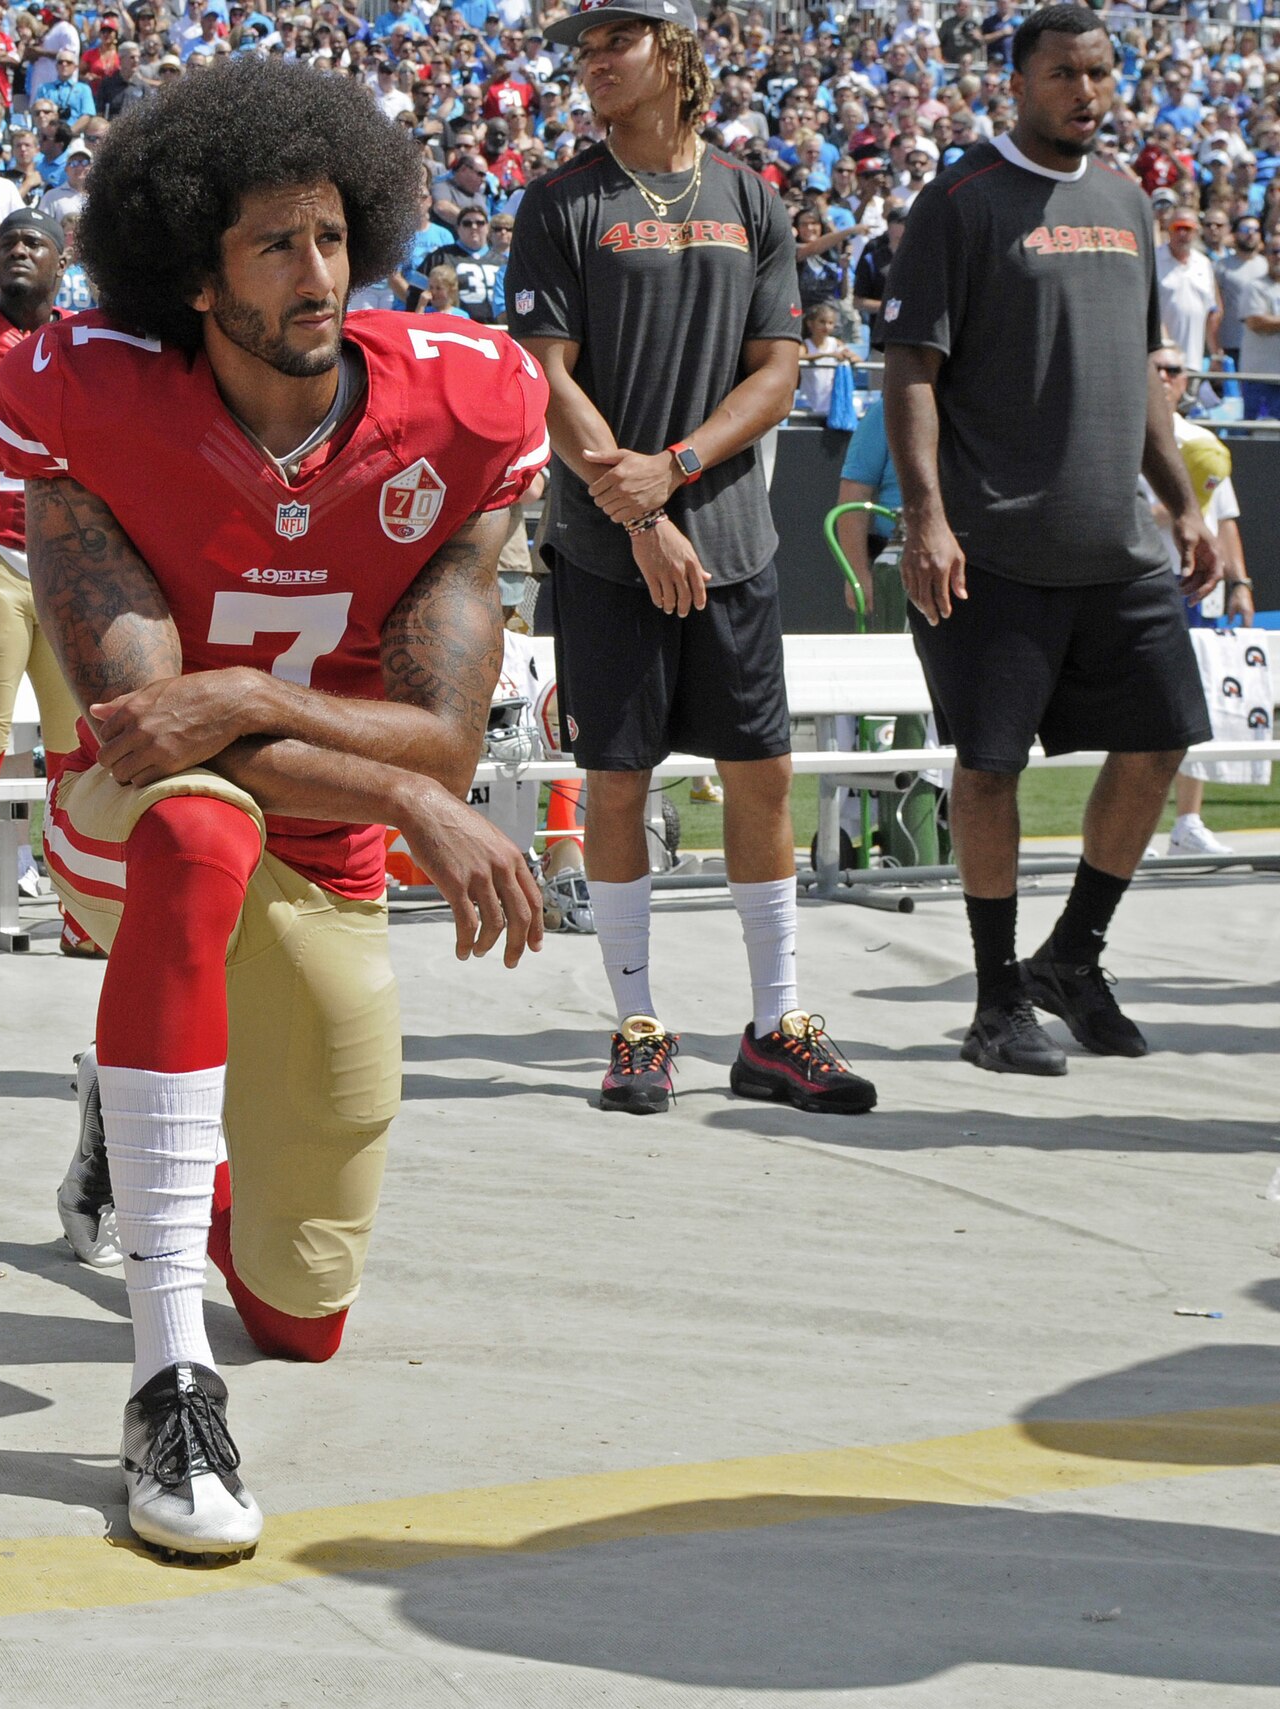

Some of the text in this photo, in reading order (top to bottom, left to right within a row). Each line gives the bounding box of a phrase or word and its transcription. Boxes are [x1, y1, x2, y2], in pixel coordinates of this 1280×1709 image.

[599, 220, 749, 252] 49ERS
[1023, 225, 1138, 255] 49ERS
[392, 491, 433, 516] 70
[280, 518, 303, 533] NFL
[240, 567, 329, 585] 49ERS
[206, 590, 354, 688] 7
